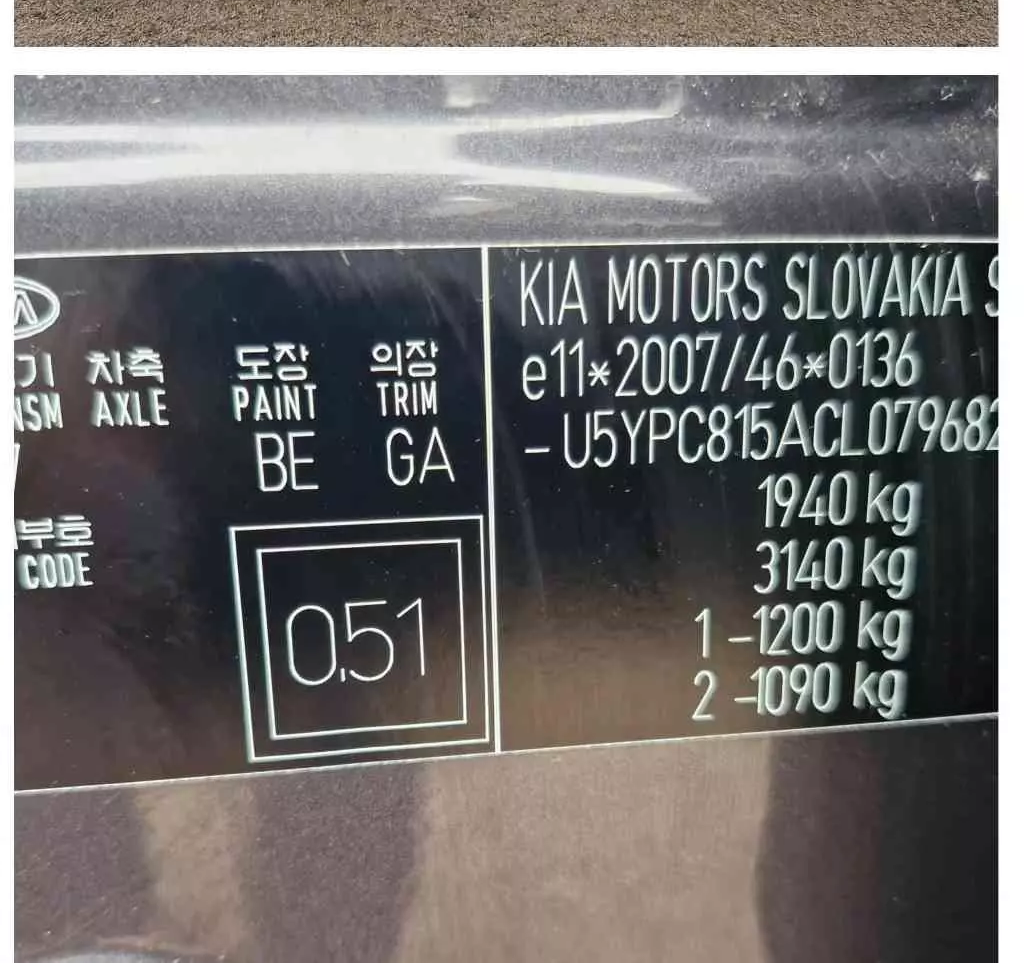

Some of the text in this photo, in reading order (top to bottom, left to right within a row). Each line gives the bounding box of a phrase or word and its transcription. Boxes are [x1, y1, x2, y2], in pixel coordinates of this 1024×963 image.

[520, 255, 588, 327] KIA
[608, 253, 768, 325] MOTORS
[781, 250, 972, 321] SLOVAKIA
[85, 346, 165, 385] 차축
[236, 341, 310, 381] 도장
[370, 339, 438, 378] 의장
[91, 388, 169, 427] AXLE
[232, 383, 318, 422] PAINT
[376, 380, 438, 418] TRIM
[255, 431, 319, 492] BE
[386, 426, 455, 486] GA
[756, 470, 922, 537] 1940 kg
[16, 514, 93, 548] 부호
[17, 551, 94, 591] CODE
[753, 537, 918, 600] 3140 kg
[286, 597, 426, 687] 0.51
[694, 608, 712, 658] 1
[857, 602, 912, 662] kg
[692, 669, 718, 721] 2
[851, 662, 908, 721] kg
